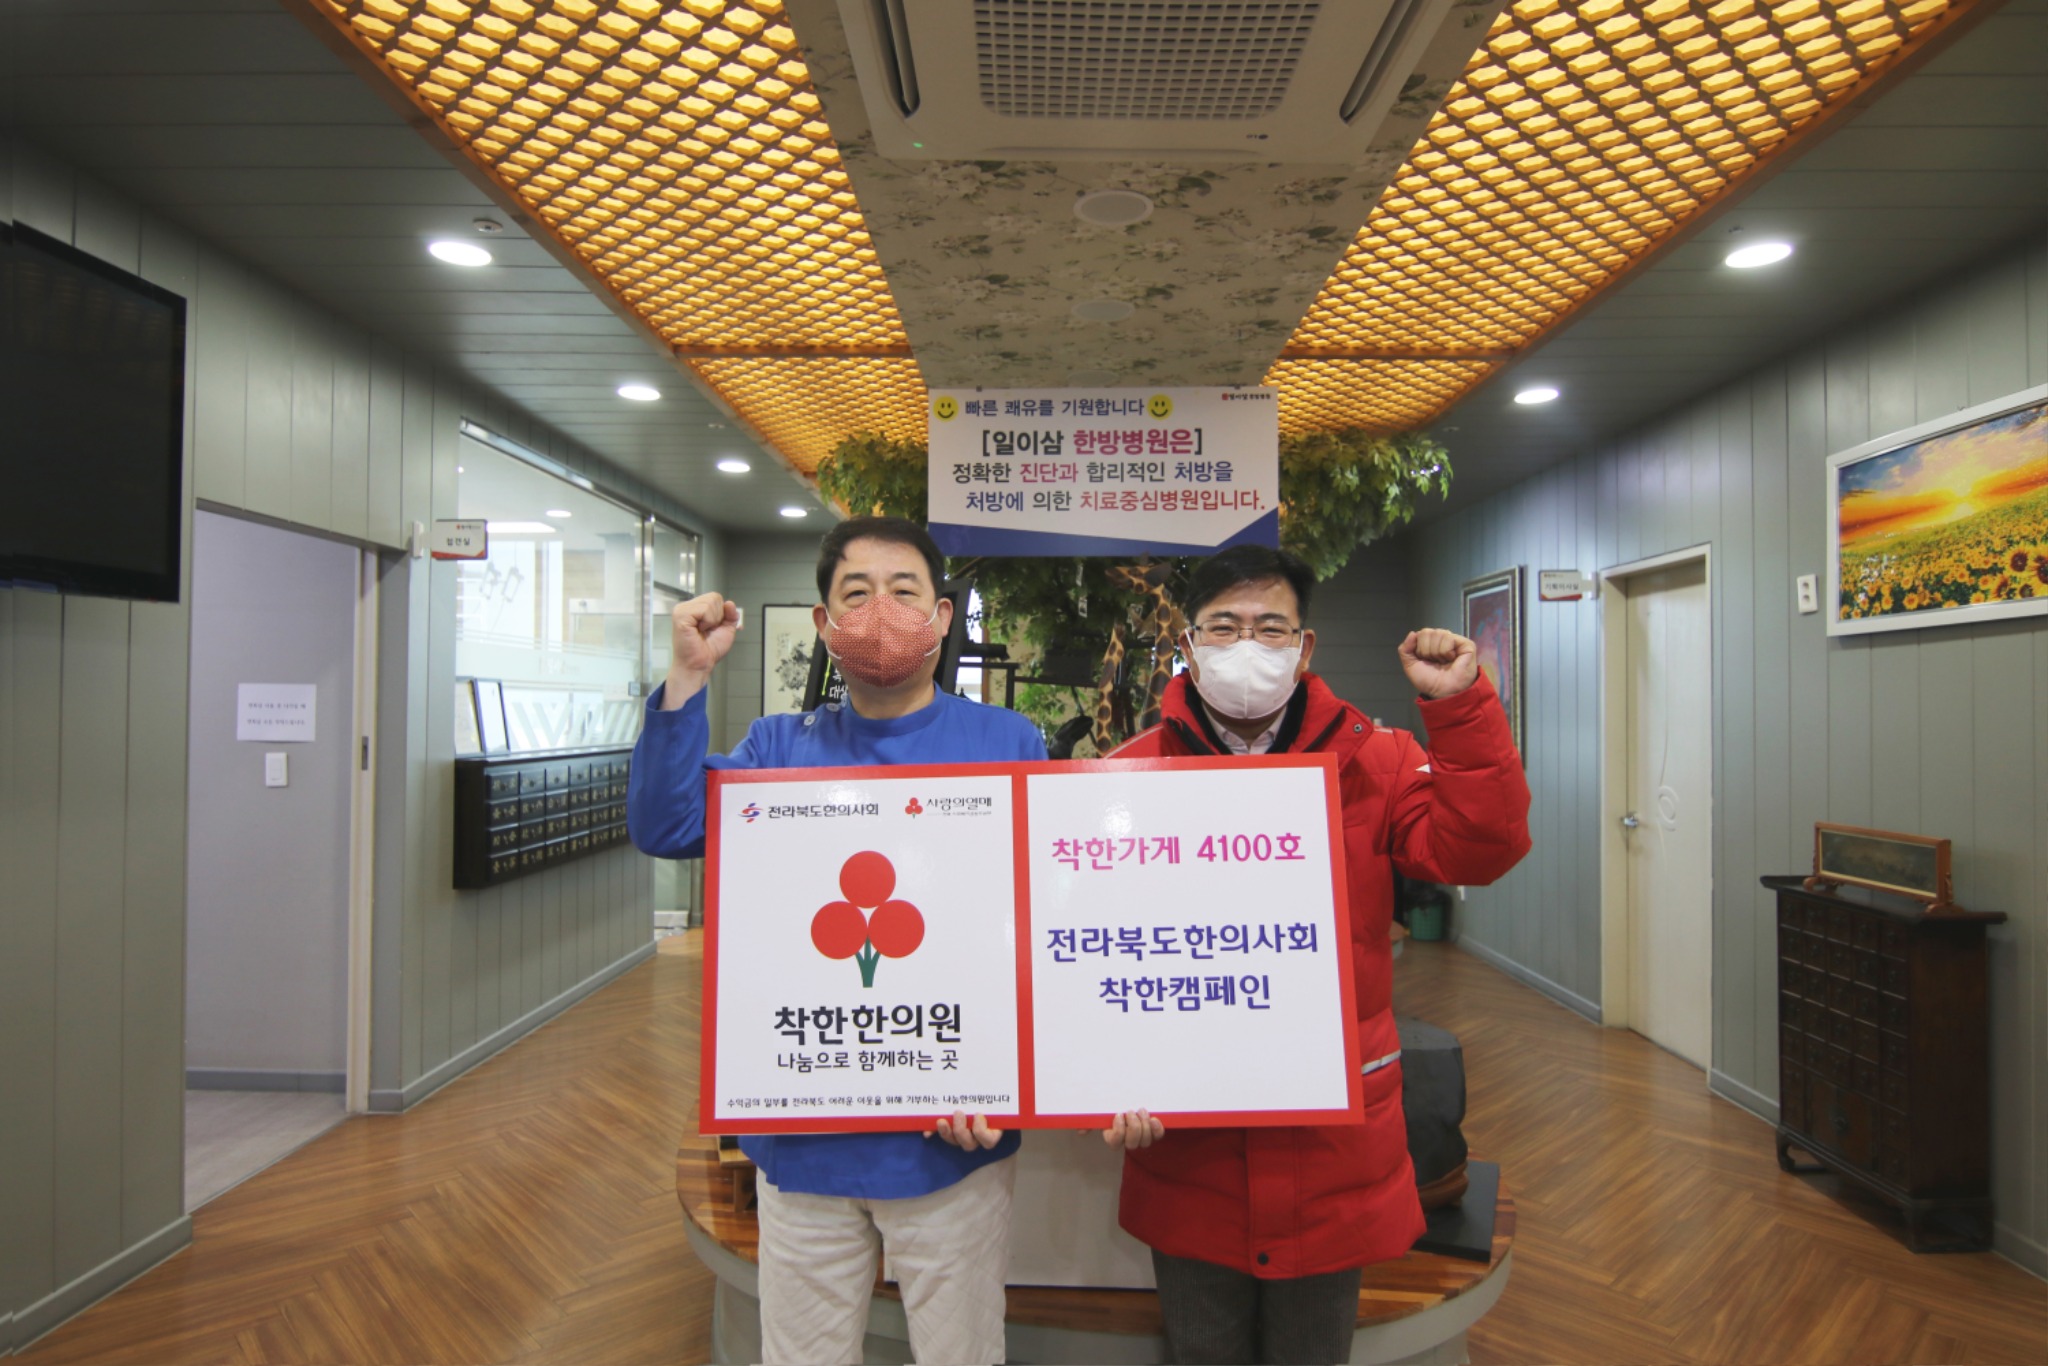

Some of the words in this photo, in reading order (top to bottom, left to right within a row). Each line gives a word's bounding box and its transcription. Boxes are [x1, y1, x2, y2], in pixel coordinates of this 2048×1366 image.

[965, 399, 999, 417] 빠른
[1004, 399, 1055, 417] 쾌유를
[1061, 398, 1145, 416] 기원합니다
[982, 429, 1064, 456] [일이삼
[1073, 428, 1203, 456] 한방병원은]
[952, 463, 1011, 483] 정확한
[1019, 462, 1078, 483] 진단과
[1086, 462, 1166, 483] 합리적인
[1174, 460, 1234, 482] 처방을
[966, 491, 1024, 512] 처방에
[1032, 491, 1072, 511] 의한
[1079, 489, 1266, 511] 치료중심병원입니다.
[768, 802, 879, 819] 전라북도한의사회
[926, 796, 992, 810] 사랑의열매
[1052, 836, 1181, 871] 착한가게
[1197, 833, 1306, 862] 4100호
[1047, 923, 1318, 962] 전라북도한의사회
[1099, 975, 1271, 1012] 착한캠페인
[774, 1003, 961, 1046] 착한한의원
[778, 1052, 850, 1073] 나눔으로
[858, 1050, 933, 1071] 함께하는
[942, 1049, 959, 1071] 곳
[764, 1098, 788, 1107] 일부를
[792, 1097, 824, 1107] 전라북도
[906, 1095, 939, 1104] 기부하는
